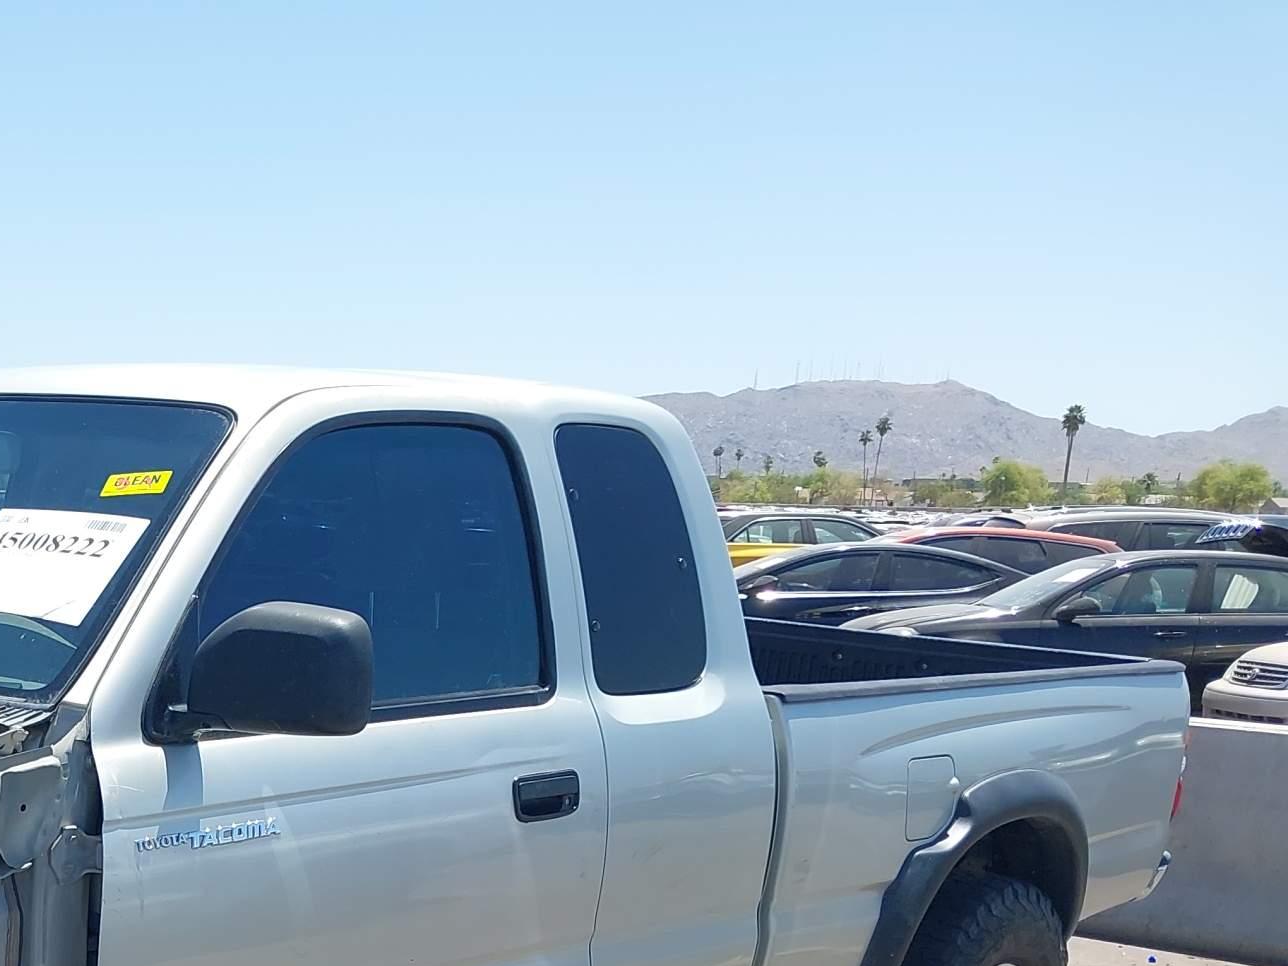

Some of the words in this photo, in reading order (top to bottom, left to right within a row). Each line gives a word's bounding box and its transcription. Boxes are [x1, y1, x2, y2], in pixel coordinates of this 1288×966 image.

[114, 474, 162, 487] CLEAN
[134, 832, 188, 853] TOYOTA
[188, 817, 281, 849] TACOMA
